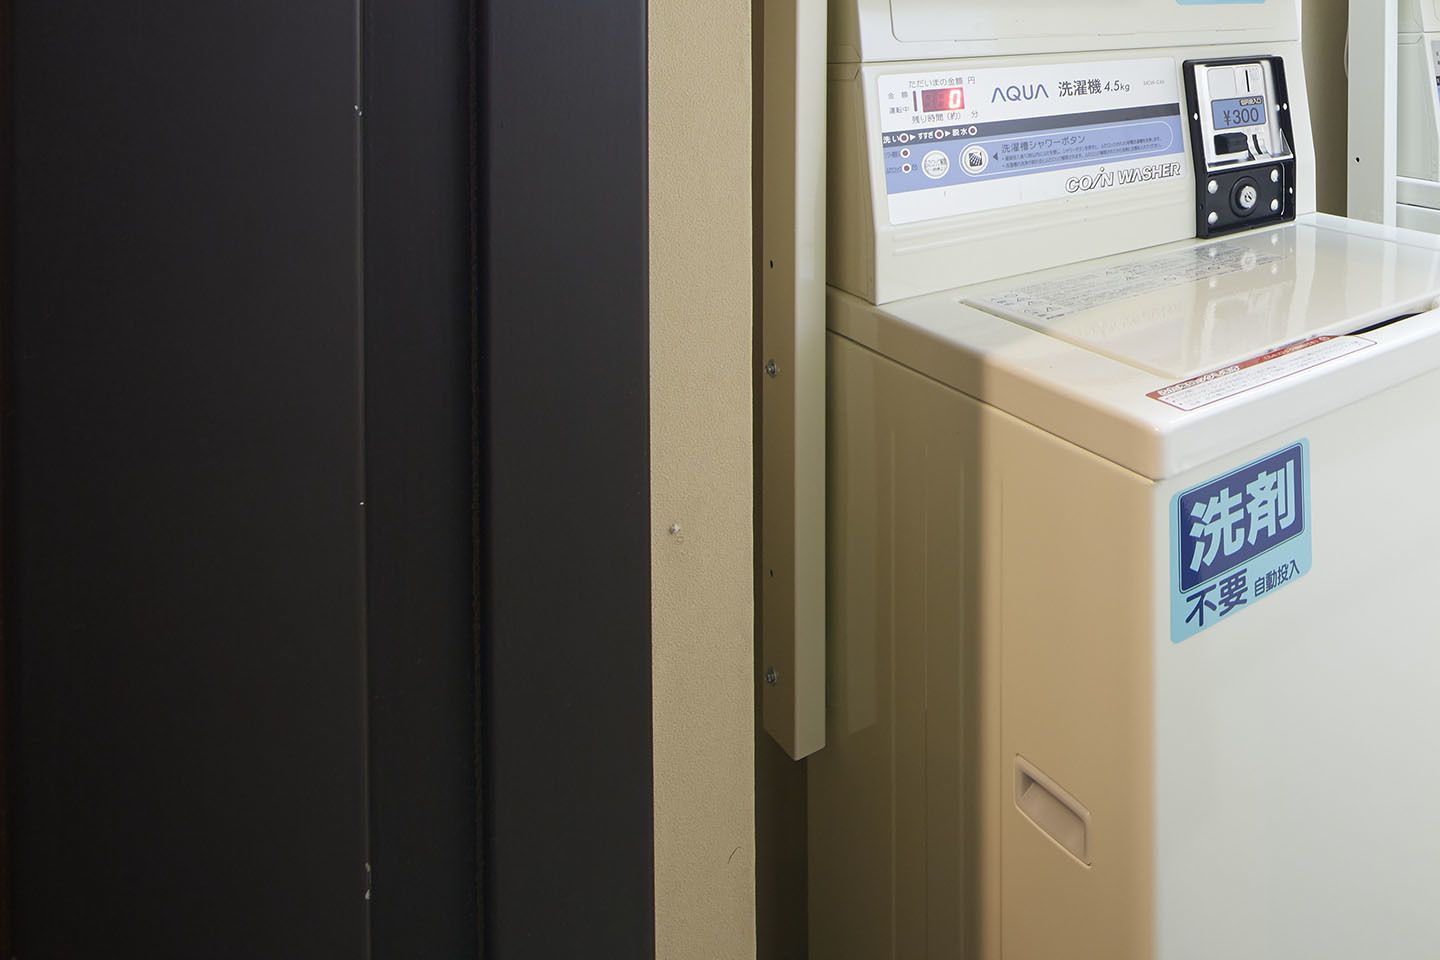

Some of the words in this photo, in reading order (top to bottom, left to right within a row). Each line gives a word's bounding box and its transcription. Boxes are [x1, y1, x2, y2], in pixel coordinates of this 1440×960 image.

[908, 77, 963, 88] ただいまの金額
[967, 76, 976, 85] 円
[991, 84, 1049, 103] AQUA
[1058, 79, 1102, 97] 洗濯機
[1104, 80, 1130, 94] 4.5kg
[949, 89, 961, 109] 0
[1223, 107, 1259, 125] ¥300
[917, 131, 934, 140] すすぎ
[952, 128, 968, 137] 脱水
[1001, 135, 1086, 153] 洗濯槽シャワーボタン
[1065, 167, 1113, 193] COIN
[1117, 162, 1181, 185] WASHER
[1189, 459, 1295, 572] 洗剤
[1185, 568, 1248, 627] 不要
[1254, 559, 1300, 598] 自動投入
